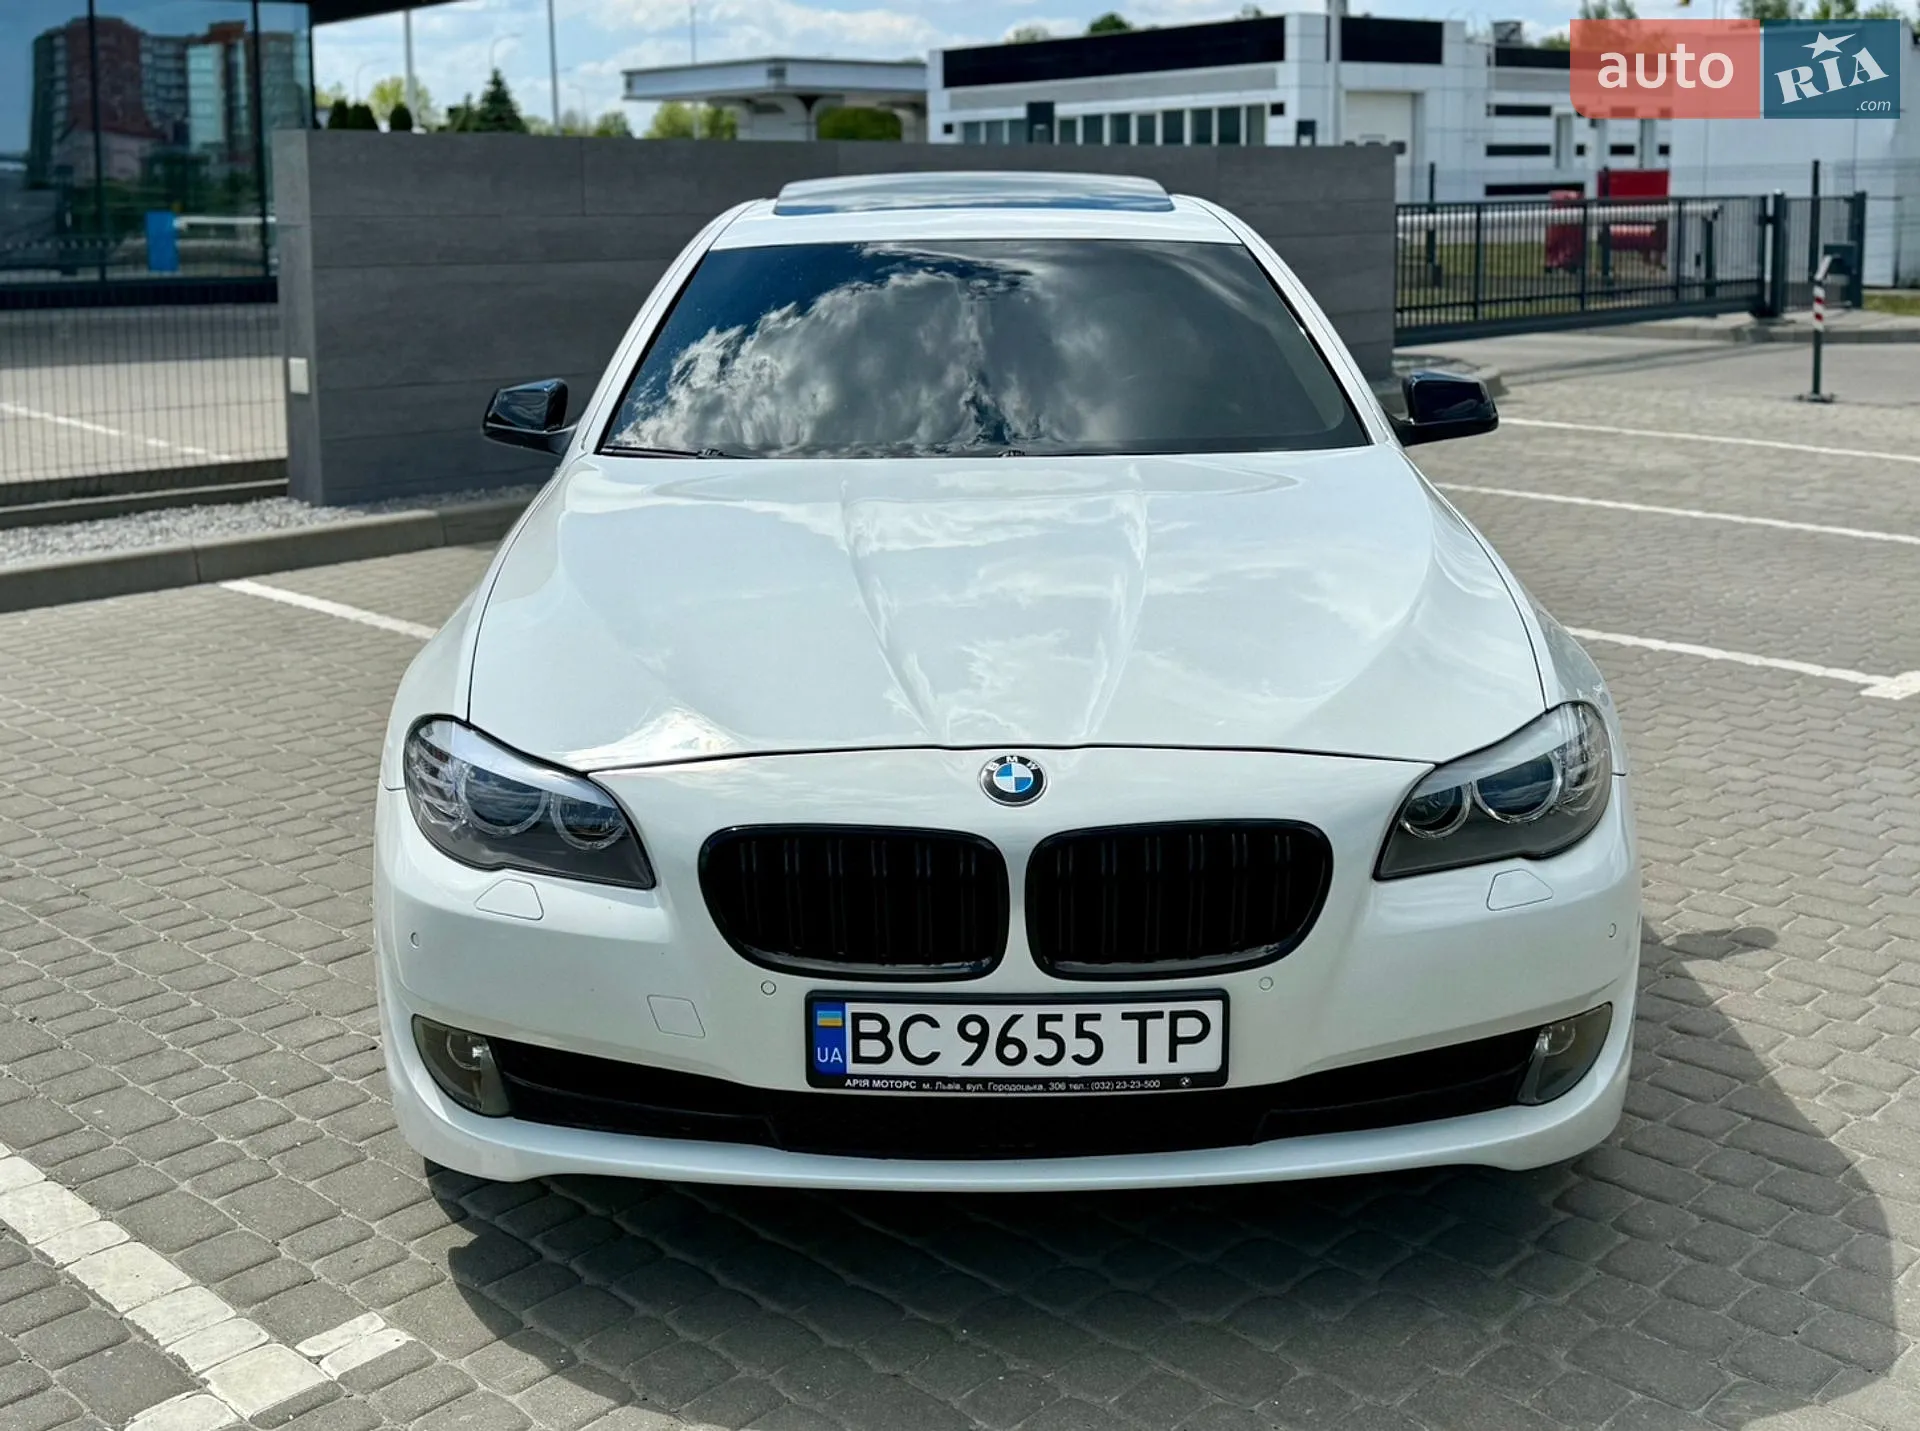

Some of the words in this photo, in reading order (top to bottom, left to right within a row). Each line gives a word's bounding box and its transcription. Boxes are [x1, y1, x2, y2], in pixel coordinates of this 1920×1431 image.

[986, 755, 1040, 771] BMW
[851, 1012, 942, 1066] BC
[956, 1013, 1104, 1067] 9655
[1120, 1010, 1212, 1064] TP
[817, 1047, 843, 1064] UA
[844, 1078, 870, 1088] АРІЯ
[872, 1079, 917, 1089] МОТОРС
[1090, 1080, 1114, 1091] (032)
[1115, 1079, 1161, 1089] 23-23-500
